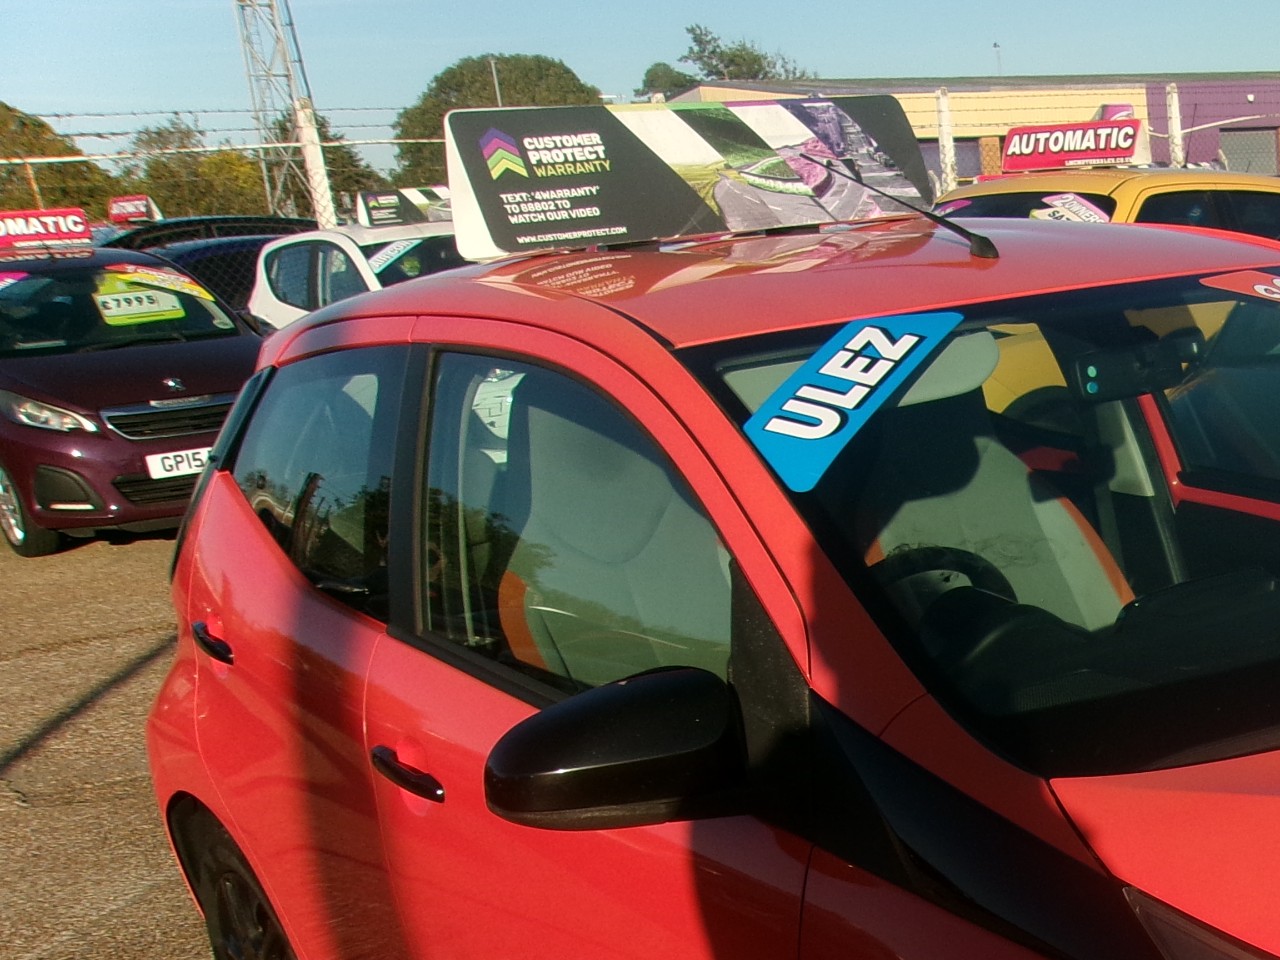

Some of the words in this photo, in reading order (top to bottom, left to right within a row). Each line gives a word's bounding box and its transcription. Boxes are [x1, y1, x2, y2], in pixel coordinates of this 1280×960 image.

[523, 132, 603, 150] CUSTOMER
[1006, 126, 1135, 156] AUTOMATIC
[527, 145, 606, 165] PROTECT
[533, 159, 612, 178] WARRANTY
[500, 191, 532, 203] TEXT:
[1057, 194, 1071, 207] 2
[503, 204, 520, 214] TO
[520, 201, 557, 213] 88802
[556, 199, 571, 209] TO
[508, 211, 546, 225] WATCH
[546, 208, 569, 221] OUR
[569, 206, 600, 219] VIDEO
[516, 226, 628, 244] WWW.CUSTOMERPROTECT.COM
[100, 294, 156, 311] £7995
[763, 325, 923, 440] ULEZ
[160, 451, 205, 473] GP15
